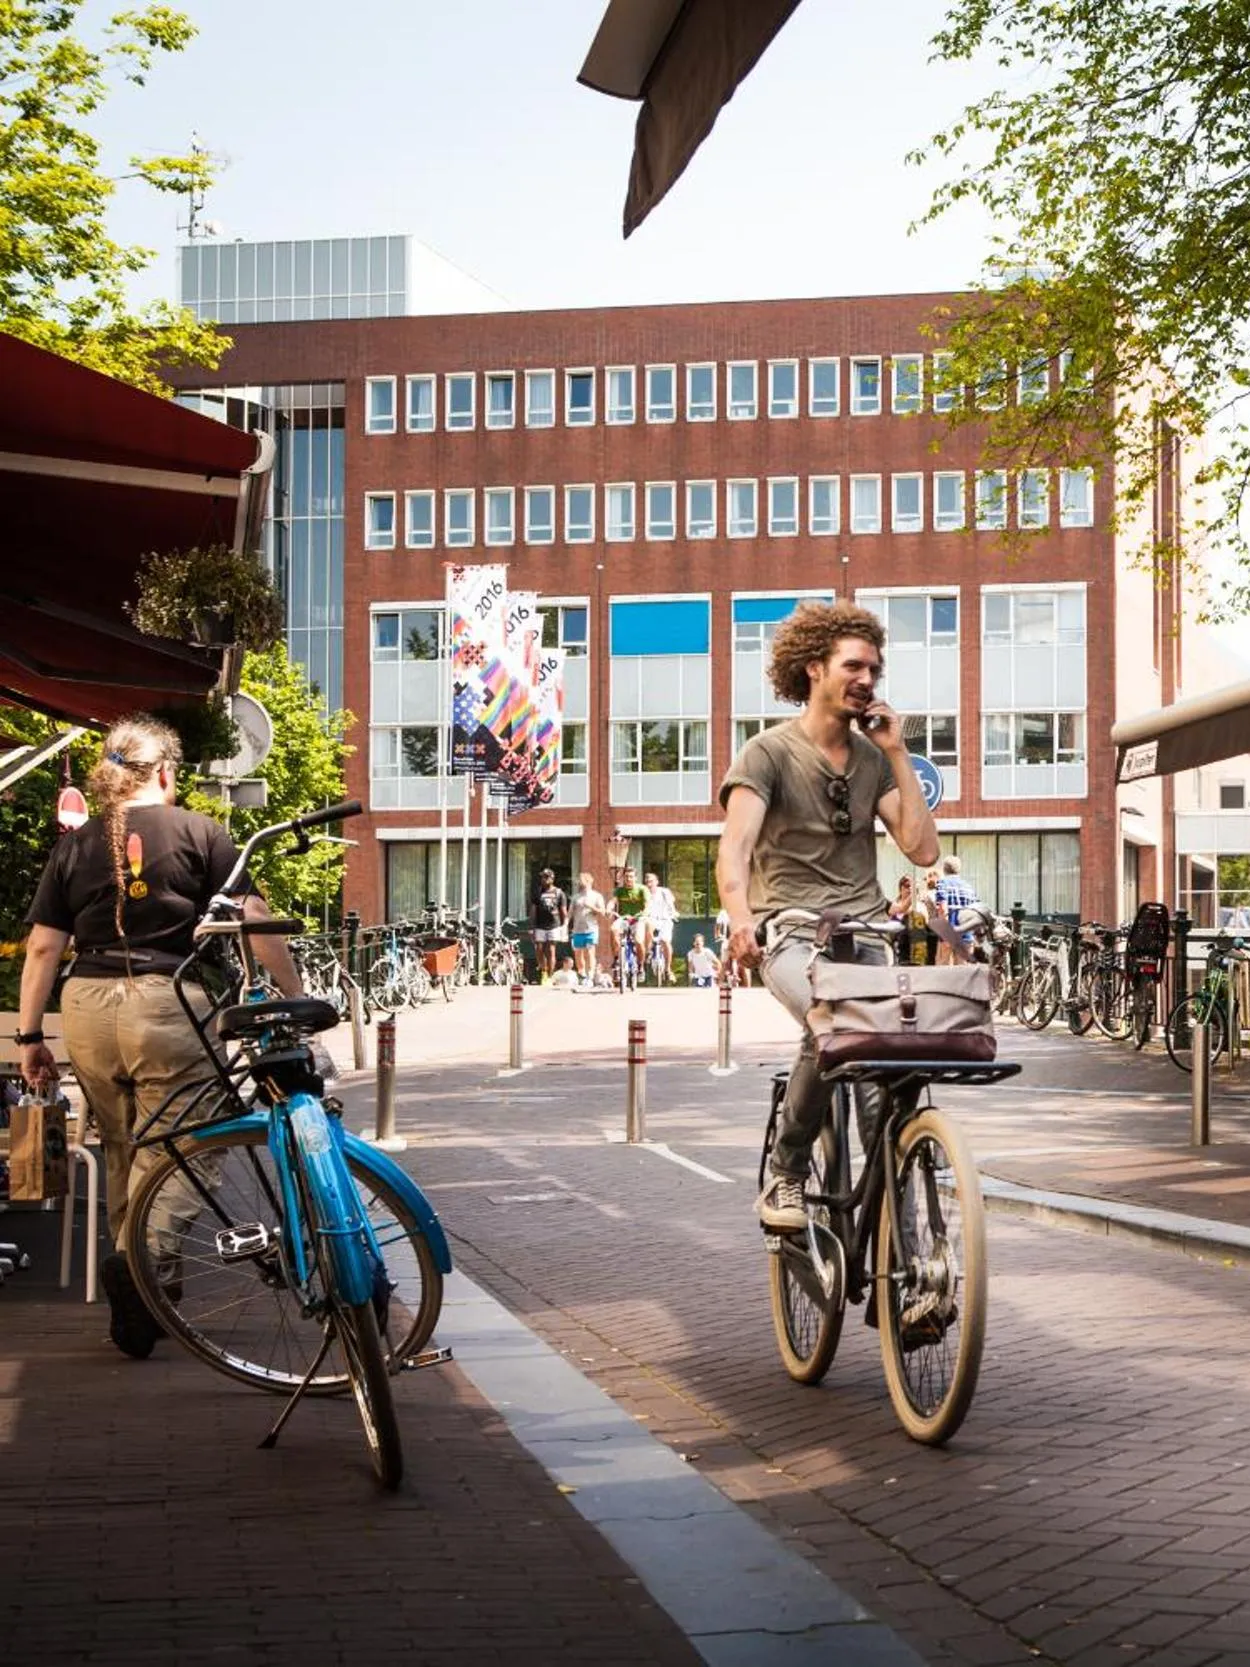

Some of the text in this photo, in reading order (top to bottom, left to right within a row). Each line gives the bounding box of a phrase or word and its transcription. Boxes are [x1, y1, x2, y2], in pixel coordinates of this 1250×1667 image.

[474, 579, 503, 620] 2016
[505, 605, 530, 634] 016
[537, 656, 558, 682] 016
